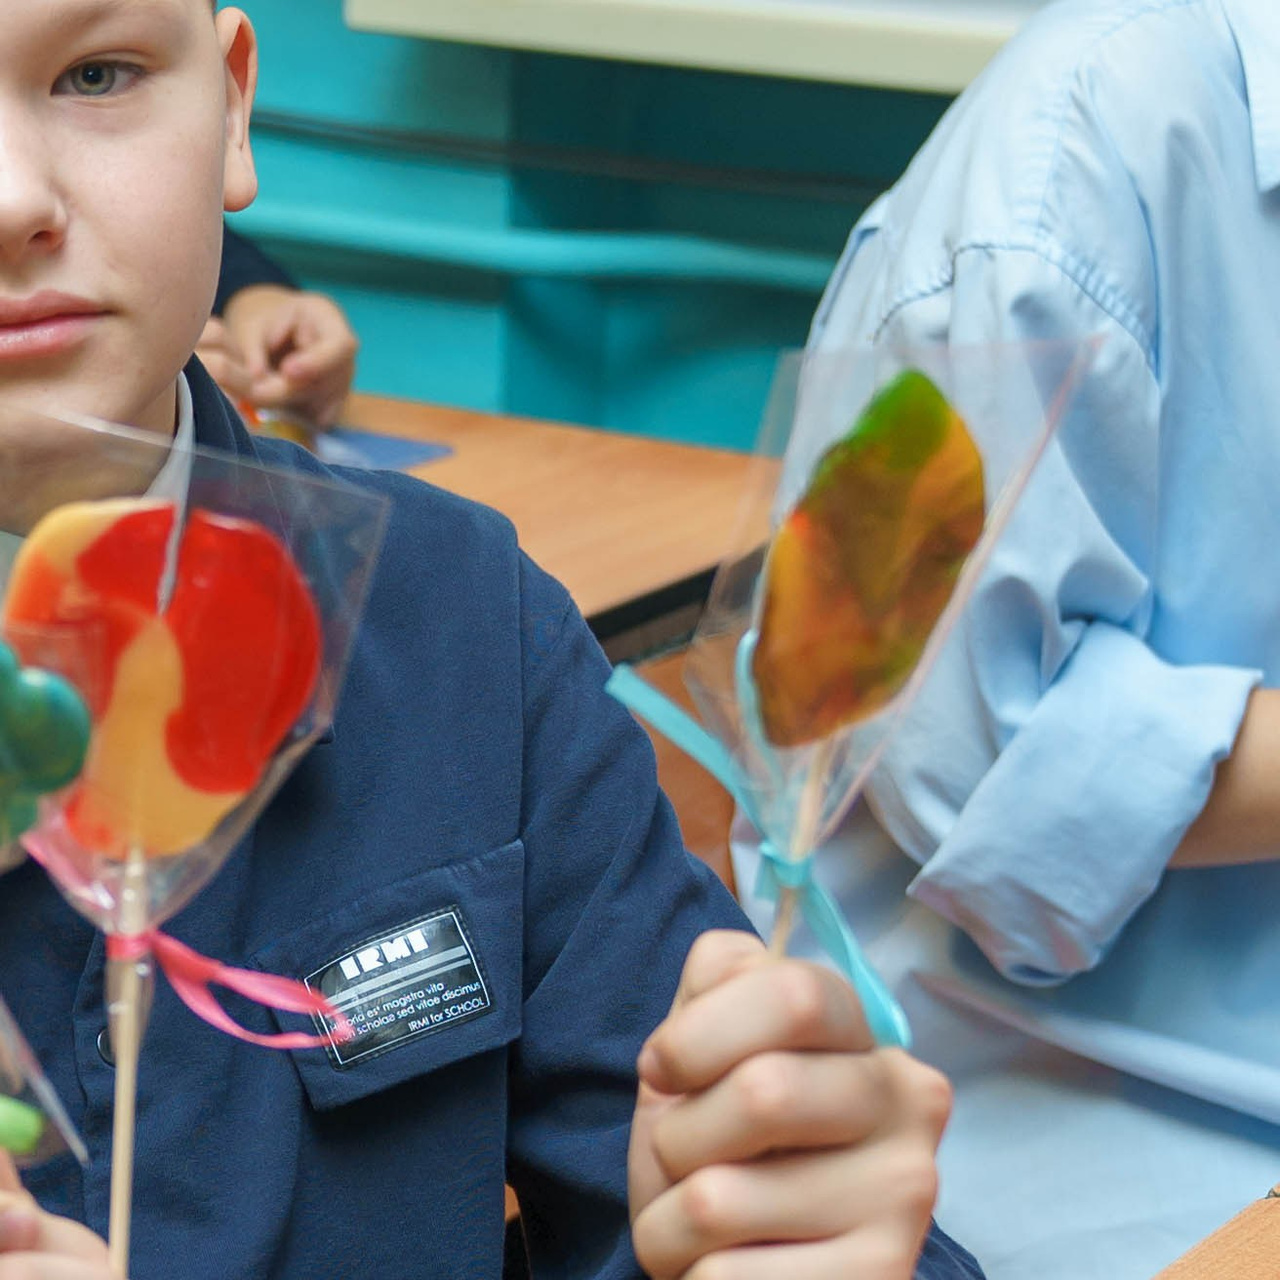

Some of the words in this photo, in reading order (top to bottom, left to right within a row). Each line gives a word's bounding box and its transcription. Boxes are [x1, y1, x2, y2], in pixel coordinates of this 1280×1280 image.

[340, 929, 429, 980] IRMI
[408, 1016, 430, 1032] IRMI
[445, 996, 485, 1018] SCHOOL
